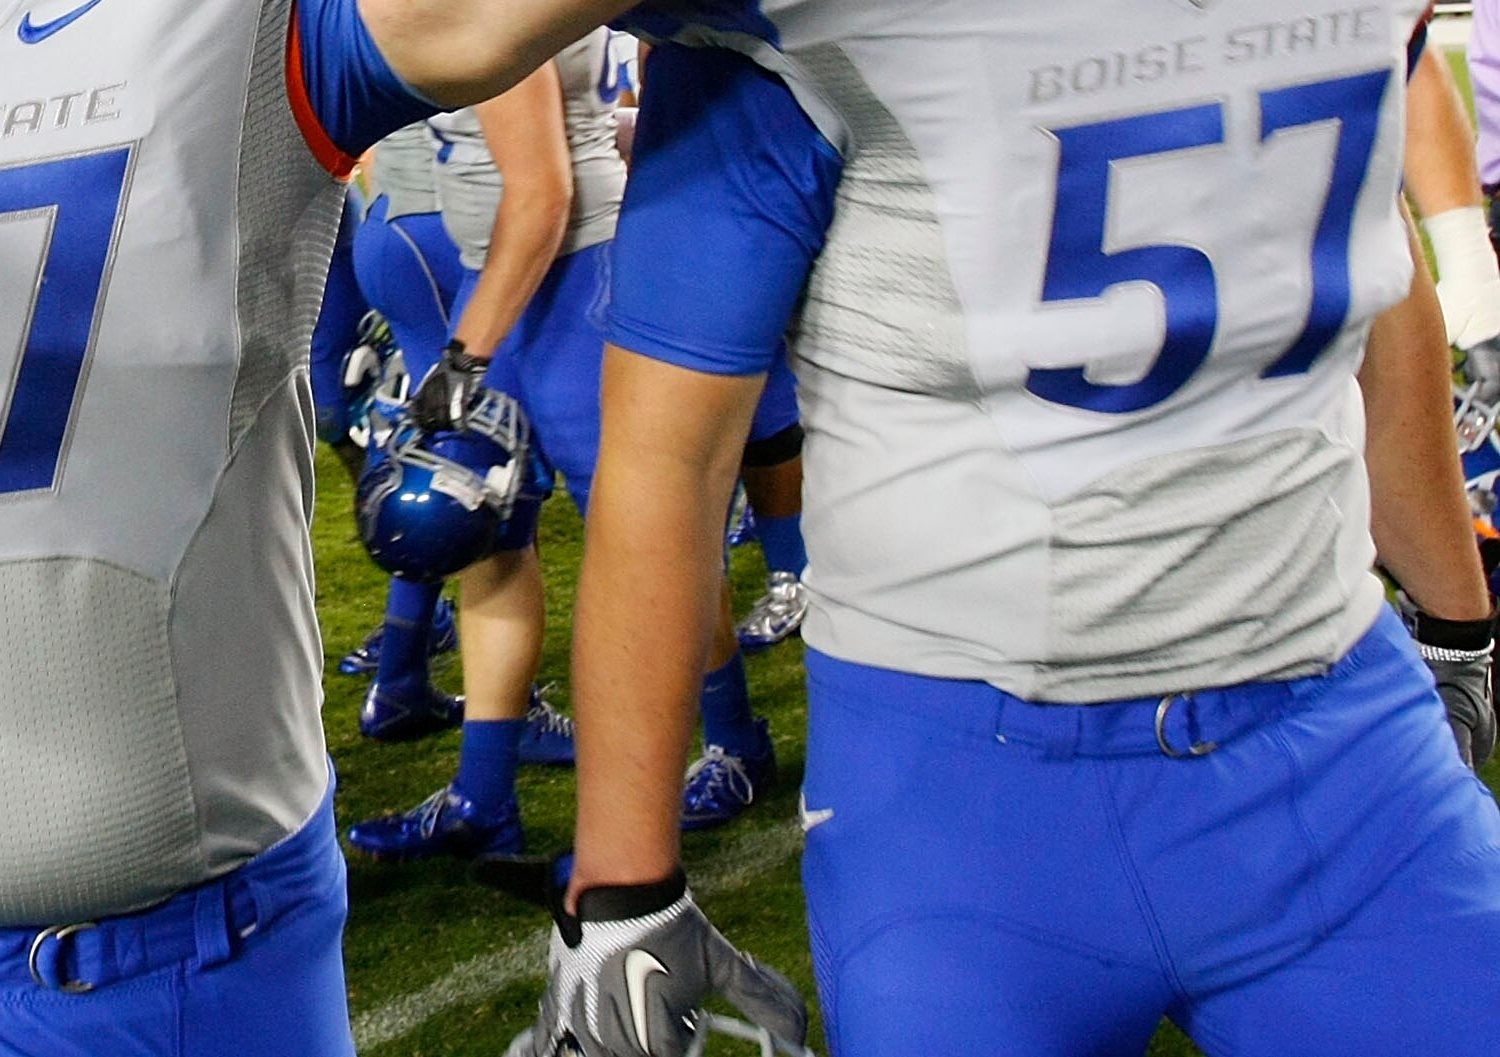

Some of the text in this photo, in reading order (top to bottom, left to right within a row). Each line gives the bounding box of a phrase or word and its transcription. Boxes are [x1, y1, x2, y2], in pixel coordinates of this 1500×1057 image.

[1027, 5, 1384, 104] BOISE STATE
[1023, 61, 1396, 416] 57
